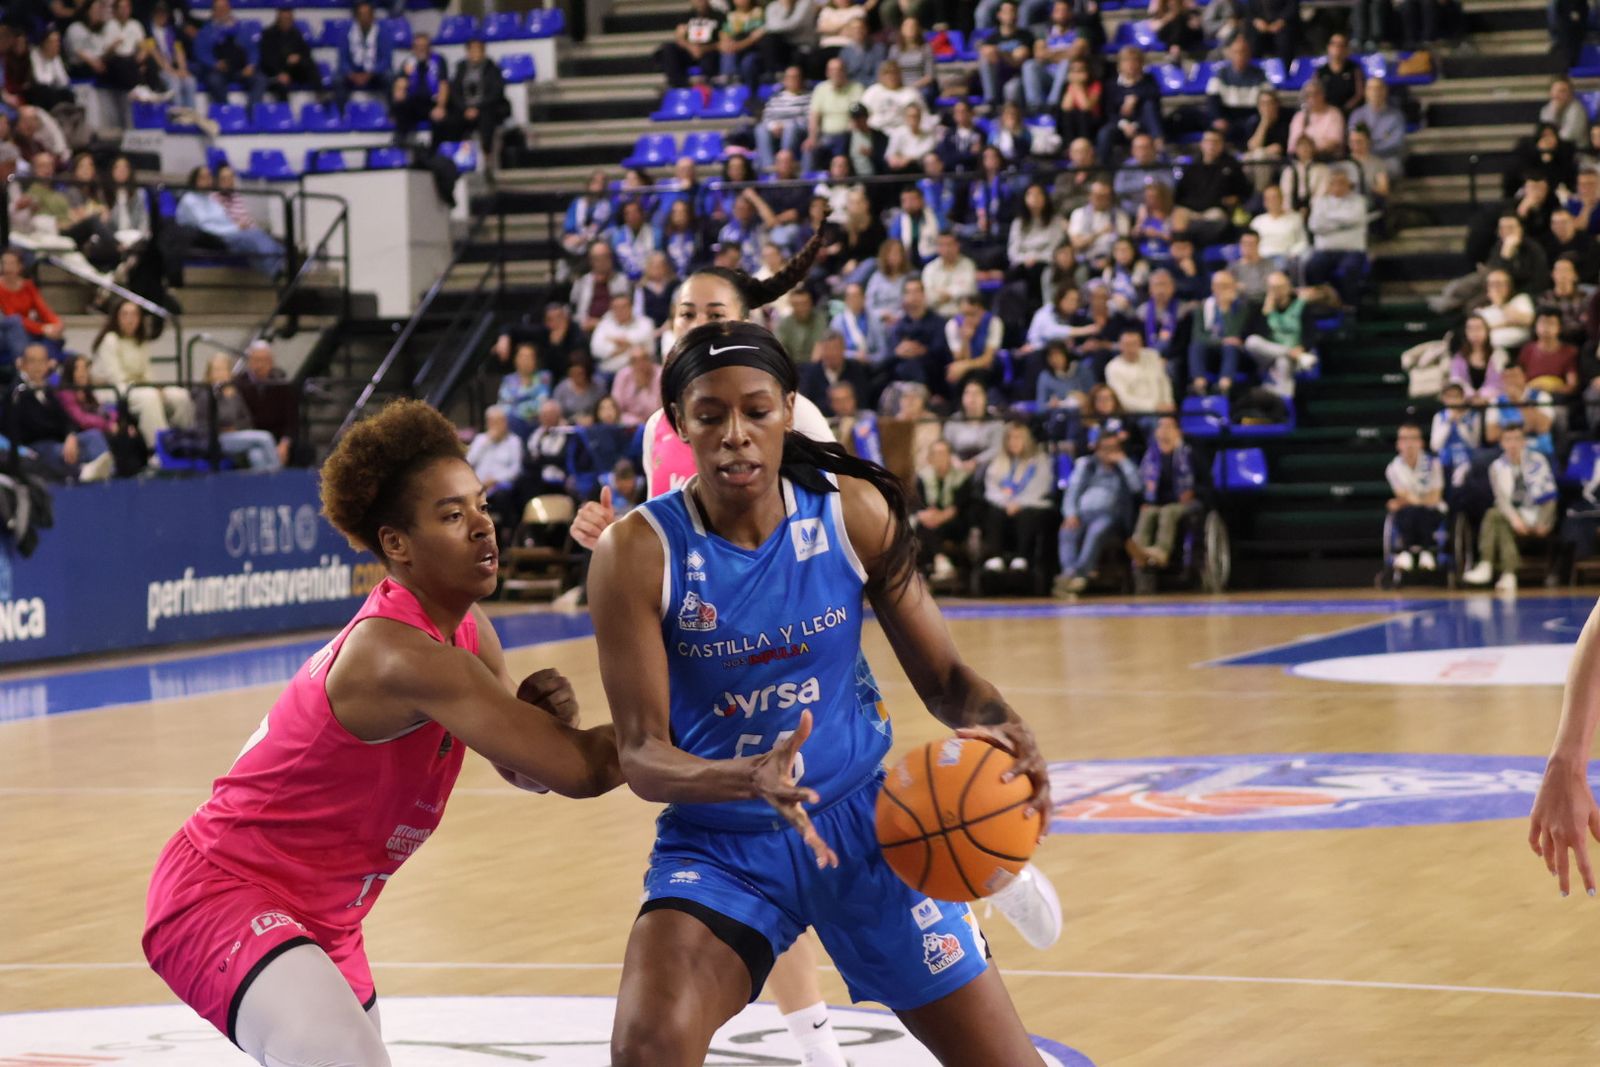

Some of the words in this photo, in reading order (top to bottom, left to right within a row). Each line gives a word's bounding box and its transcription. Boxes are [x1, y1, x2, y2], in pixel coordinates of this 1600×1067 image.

[678, 633, 771, 657] CASTILLA
[779, 625, 793, 643] Y
[802, 606, 847, 636] LEÓN
